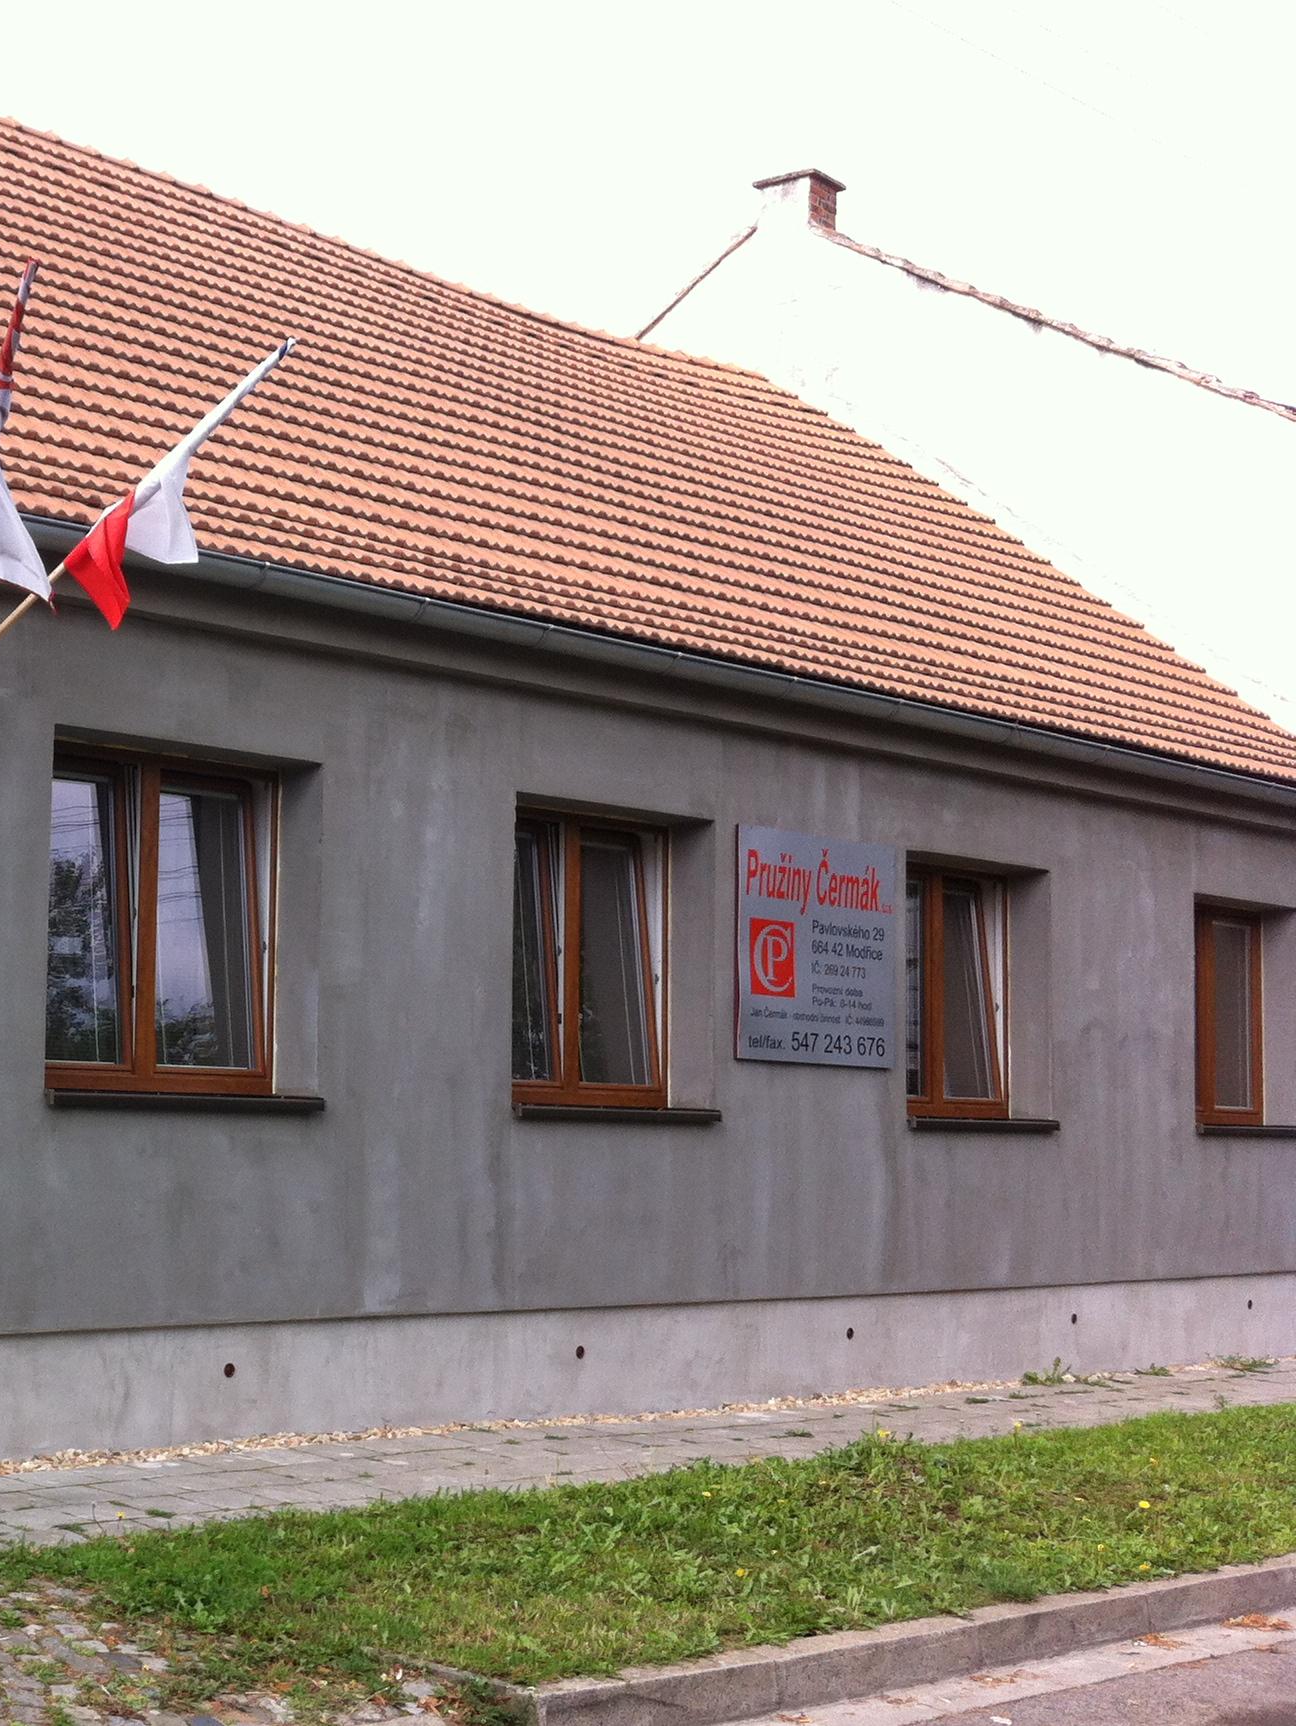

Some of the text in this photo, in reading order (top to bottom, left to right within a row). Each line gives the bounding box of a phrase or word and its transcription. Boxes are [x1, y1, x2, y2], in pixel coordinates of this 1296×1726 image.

[746, 849, 812, 916] Pružiny
[816, 848, 880, 912] Čermák
[812, 920, 885, 941] Pavlovského 29
[811, 939, 883, 961] 664 42 Modřice
[824, 964, 839, 977] 269
[840, 965, 850, 977] 24
[851, 966, 866, 979] 773
[791, 1032, 819, 1052] 547
[824, 1034, 852, 1055] 243
[857, 1036, 885, 1057] 676
